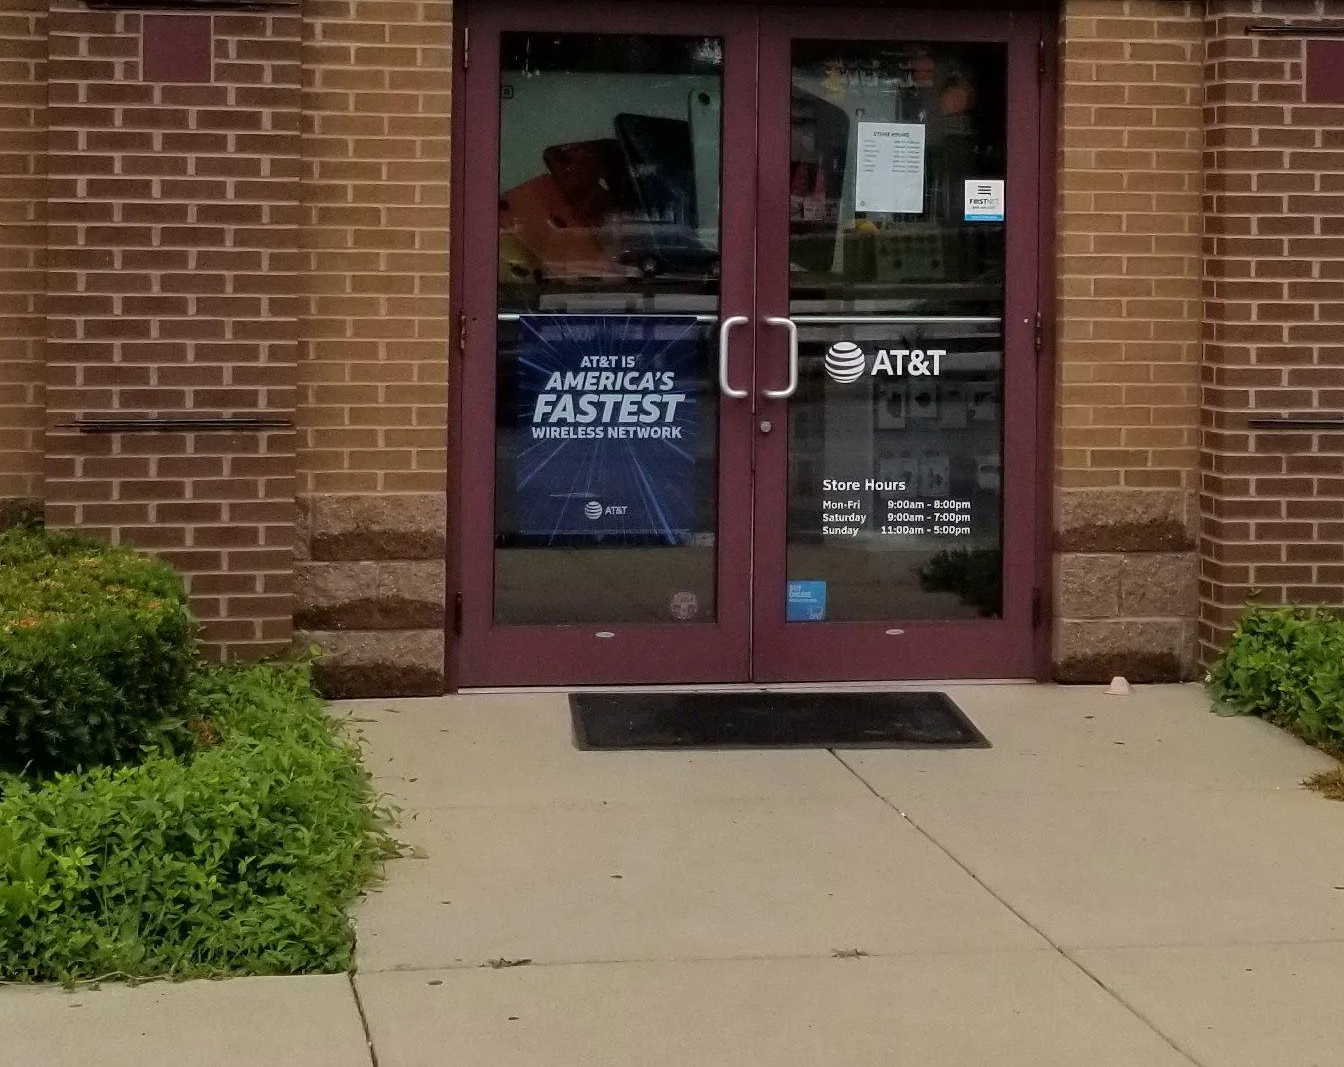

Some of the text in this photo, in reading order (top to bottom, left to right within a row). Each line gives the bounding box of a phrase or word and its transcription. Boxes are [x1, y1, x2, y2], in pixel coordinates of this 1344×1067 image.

[580, 355, 636, 368] AT&T IS
[870, 349, 947, 376] AT&T
[544, 371, 675, 391] AMERICA’S
[533, 394, 685, 423] FASTEST
[531, 426, 682, 439] WIRELESS NETWORK
[822, 479, 906, 491] Store Hours
[604, 505, 628, 515] AT&T
[822, 500, 861, 509] Mon-Fri
[887, 500, 925, 509] 9:00am
[933, 500, 971, 511] 8:00pm
[822, 513, 867, 524] Saturday
[887, 513, 924, 522] 9:00am
[933, 513, 971, 523] 7:00pm
[822, 526, 859, 537] Sunday
[881, 526, 924, 535] 11:00am
[933, 526, 971, 536] 5:00pm
